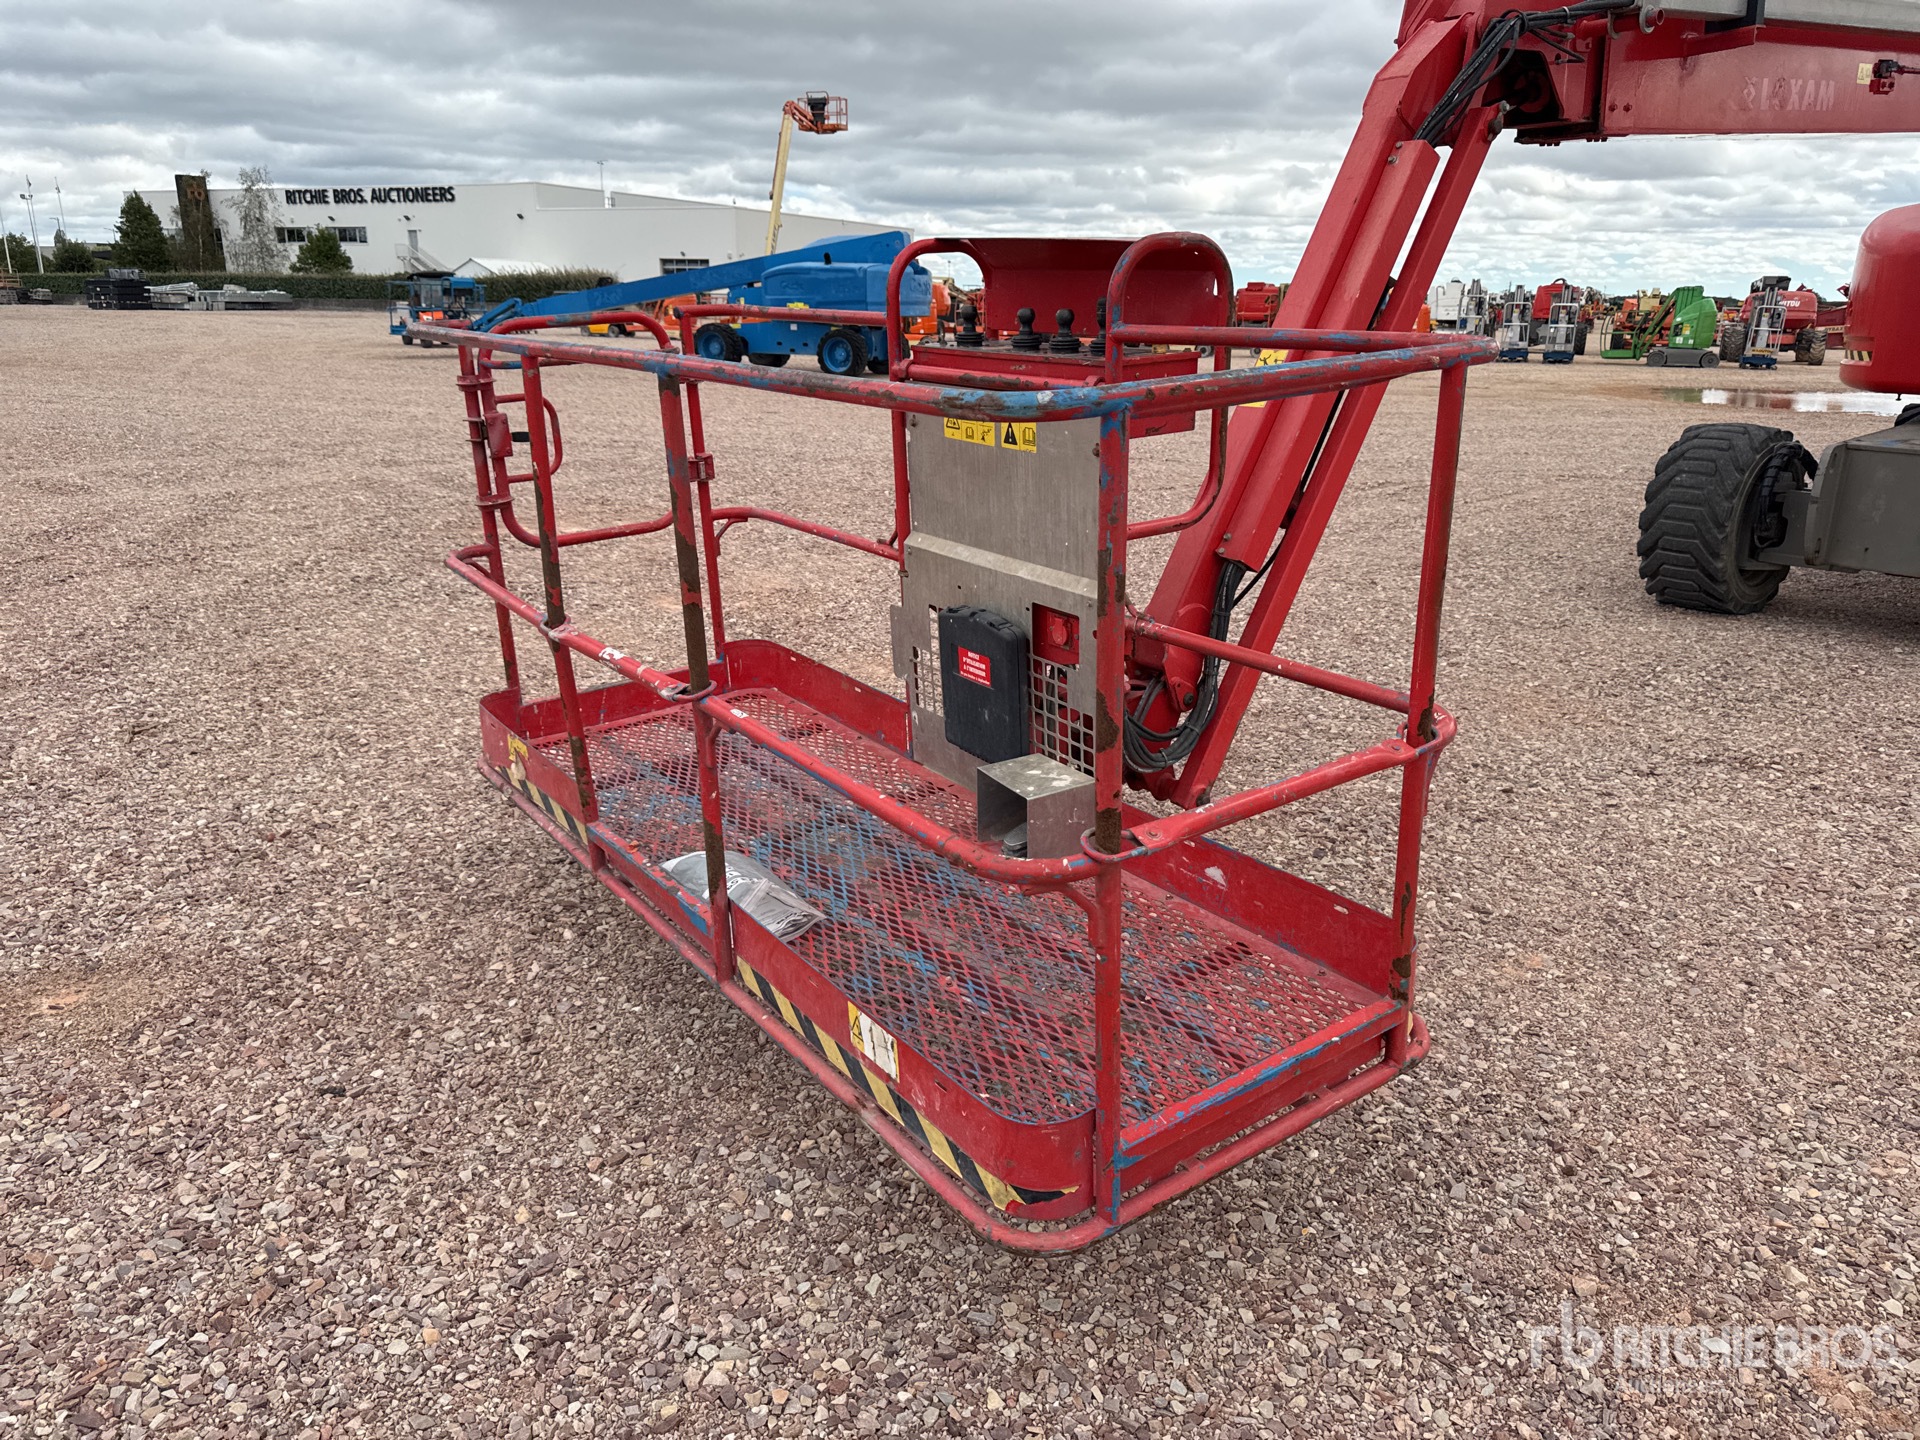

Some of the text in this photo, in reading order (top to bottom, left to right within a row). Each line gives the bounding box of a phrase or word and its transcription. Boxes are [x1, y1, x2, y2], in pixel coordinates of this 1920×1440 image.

[285, 186, 455, 205] RITCHIE BROS. AUCTIONEERS
